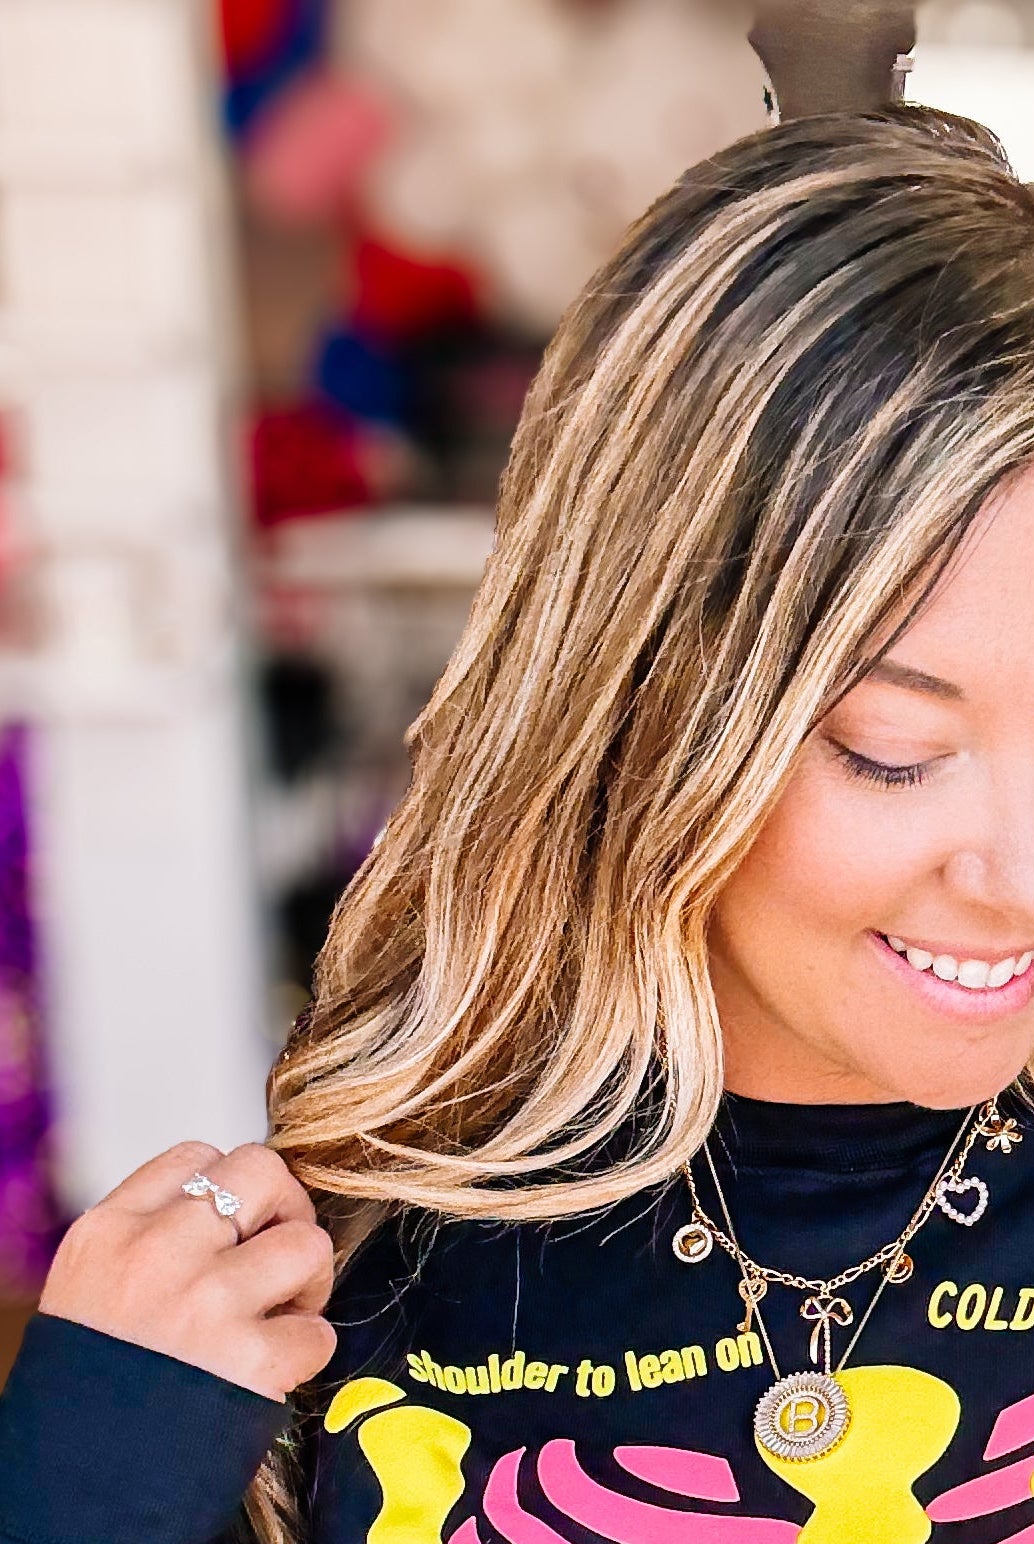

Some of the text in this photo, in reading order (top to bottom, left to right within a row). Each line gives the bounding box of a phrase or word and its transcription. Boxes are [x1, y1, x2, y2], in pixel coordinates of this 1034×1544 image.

[407, 1331, 764, 1398] shoulder to lean on
[788, 1395, 819, 1437] B
